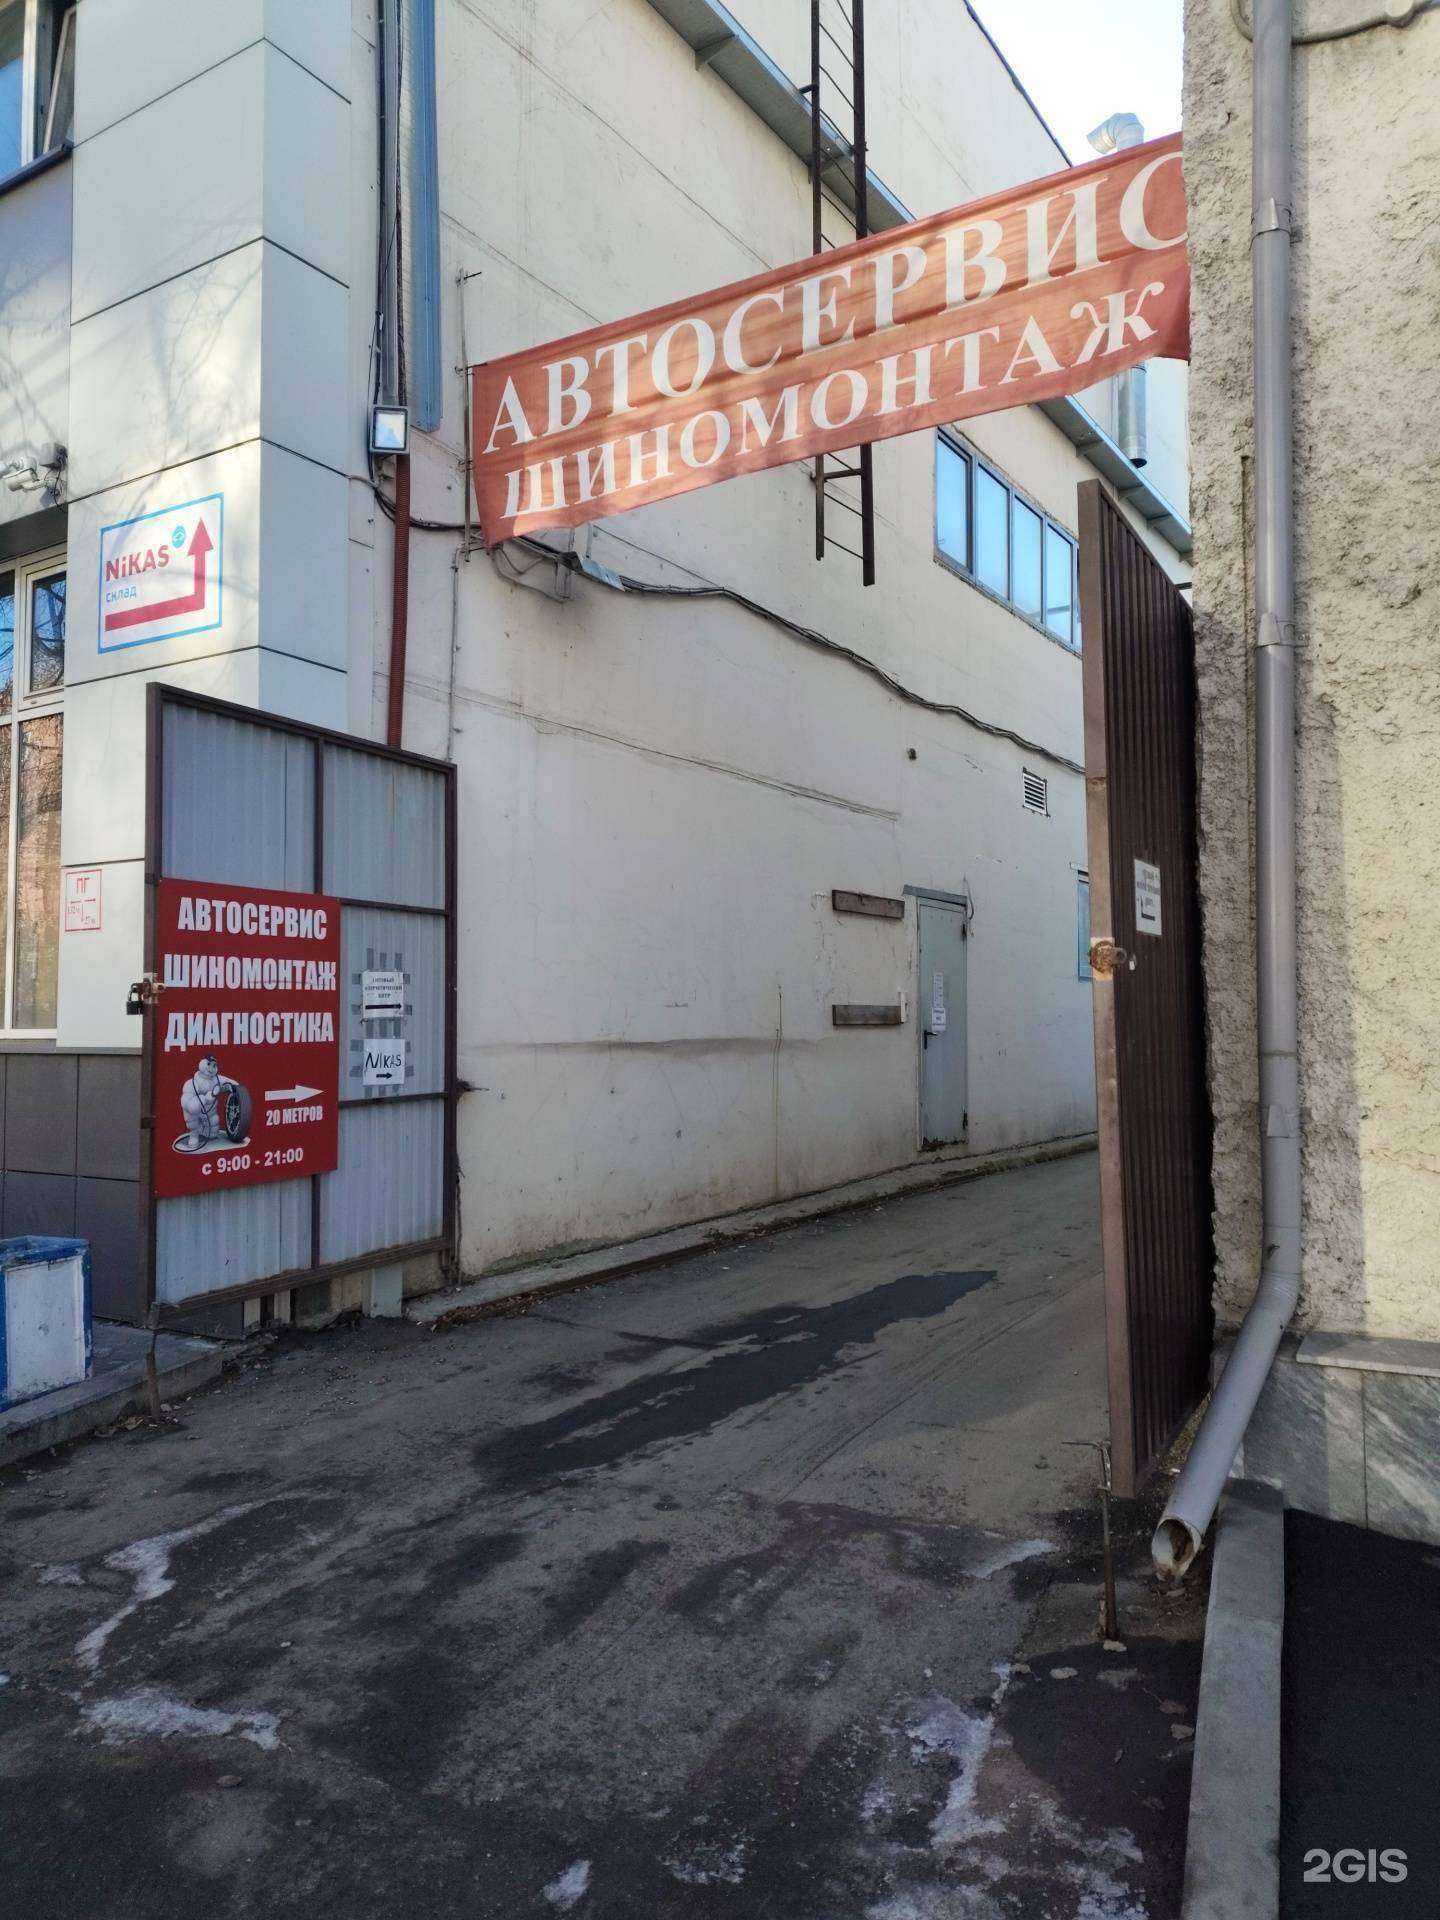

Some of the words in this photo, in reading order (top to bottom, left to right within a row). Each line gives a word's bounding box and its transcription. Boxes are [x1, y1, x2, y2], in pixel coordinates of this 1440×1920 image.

[483, 151, 1188, 454] АВТОСЕРВИС
[499, 281, 1165, 519] ШИНОМОНТАЖ
[106, 586, 137, 603] склад
[178, 897, 327, 940] АВТОСЕРВИС
[164, 954, 336, 991] ШИНОМОНТАЖ
[164, 1012, 335, 1052] ДИАГНОСТИКА
[266, 1109, 281, 1126] 20
[282, 1106, 324, 1124] МЕТРОВ
[217, 1154, 251, 1173] 9:00
[264, 1147, 304, 1166] 21:00
